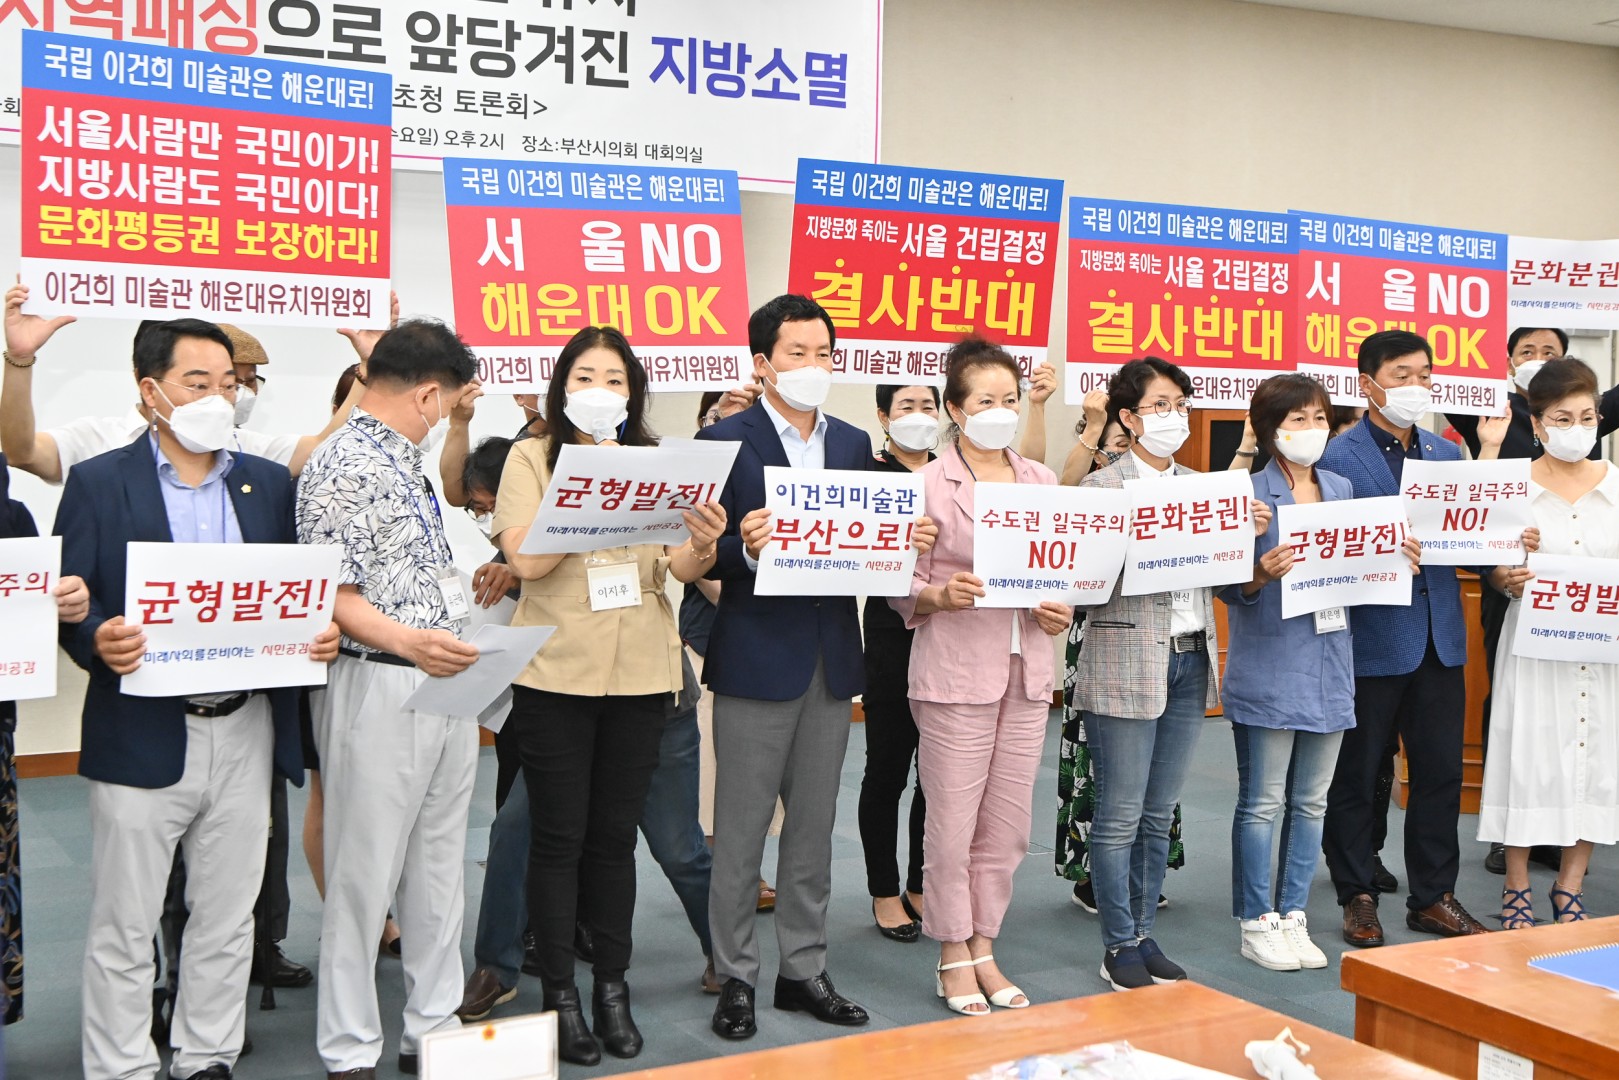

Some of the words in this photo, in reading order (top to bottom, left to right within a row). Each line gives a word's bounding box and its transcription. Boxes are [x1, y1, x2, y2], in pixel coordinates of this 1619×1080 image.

[44, 43, 92, 80] 국립
[103, 50, 173, 89] 이건희
[184, 59, 273, 99] 미술관은
[282, 71, 374, 110] 해운대로!
[406, 10, 630, 89] 앞당겨진
[649, 36, 848, 109] 지방소멸
[454, 90, 548, 119] 토론회>
[37, 105, 222, 161] 서울사람만
[236, 126, 379, 174] 국민이가!
[645, 144, 702, 164] 대회의실
[37, 156, 221, 206] 지방사람도
[235, 174, 379, 219] 국민이다!
[461, 167, 500, 196] 국립
[508, 168, 563, 197] 이건희
[571, 172, 643, 201] 미술관은
[650, 175, 725, 203] 해운대로!
[811, 170, 845, 197] 국립
[852, 172, 901, 201] 이건희
[908, 178, 973, 207] 미술관은
[979, 183, 1049, 212] 해운대로!
[38, 205, 220, 255] 문화평등권
[235, 220, 379, 264] 보장하라!
[805, 216, 857, 240] 지방문화
[861, 219, 899, 243] 죽이는
[900, 223, 948, 258] 서울
[956, 226, 1046, 265] 건립결정
[1082, 207, 1111, 232] 국립
[1118, 209, 1161, 236] 이건희
[1167, 213, 1223, 240] 미술관은
[1228, 218, 1288, 244] 해운대로!
[1300, 218, 1327, 243] 국립
[1333, 222, 1373, 248] 이건희
[1380, 228, 1433, 255] 미술관은
[1438, 235, 1497, 260] 해운대로!
[640, 223, 722, 273] NO
[1080, 249, 1125, 272] 지방문화
[1129, 253, 1161, 275] 죽이는
[1164, 256, 1204, 288] 서울
[1212, 258, 1289, 294] 건립결정
[1510, 260, 1619, 288] 문화분권
[45, 271, 115, 307] 이건희
[126, 276, 193, 311] 미술관
[201, 280, 371, 318] 해운대유치위원회
[480, 283, 633, 337] 해운대
[644, 285, 727, 335] OK
[811, 271, 1036, 336] 결사반대
[1429, 272, 1490, 319] NO
[1088, 301, 1283, 361] 결사반대
[1427, 324, 1489, 369] OK
[478, 356, 533, 384] 이건희
[854, 349, 902, 375] 미술관
[1080, 372, 1110, 394] 이건
[555, 476, 717, 512] 균형발전!
[776, 483, 917, 515] 이건희미술관
[1405, 483, 1458, 502] 수도권
[1468, 482, 1527, 502] 일극주의
[770, 518, 914, 555] 부산으로!
[980, 509, 1040, 533] 수도권
[1053, 512, 1125, 535] 일극주의
[1133, 495, 1248, 541] 문화분권!
[1442, 507, 1489, 532] NO!
[1028, 540, 1077, 570] NO!
[1213, 549, 1244, 562] 시민공감
[1290, 522, 1406, 562] 균형발전!
[865, 561, 903, 572] 시민공감
[1073, 580, 1106, 590] 시민공감
[1362, 572, 1398, 583] 시민공감
[138, 579, 328, 625] 균형발전!
[597, 584, 630, 599] 이지후
[261, 643, 310, 657] 시민공감
[1271, 922, 1279, 931] M
